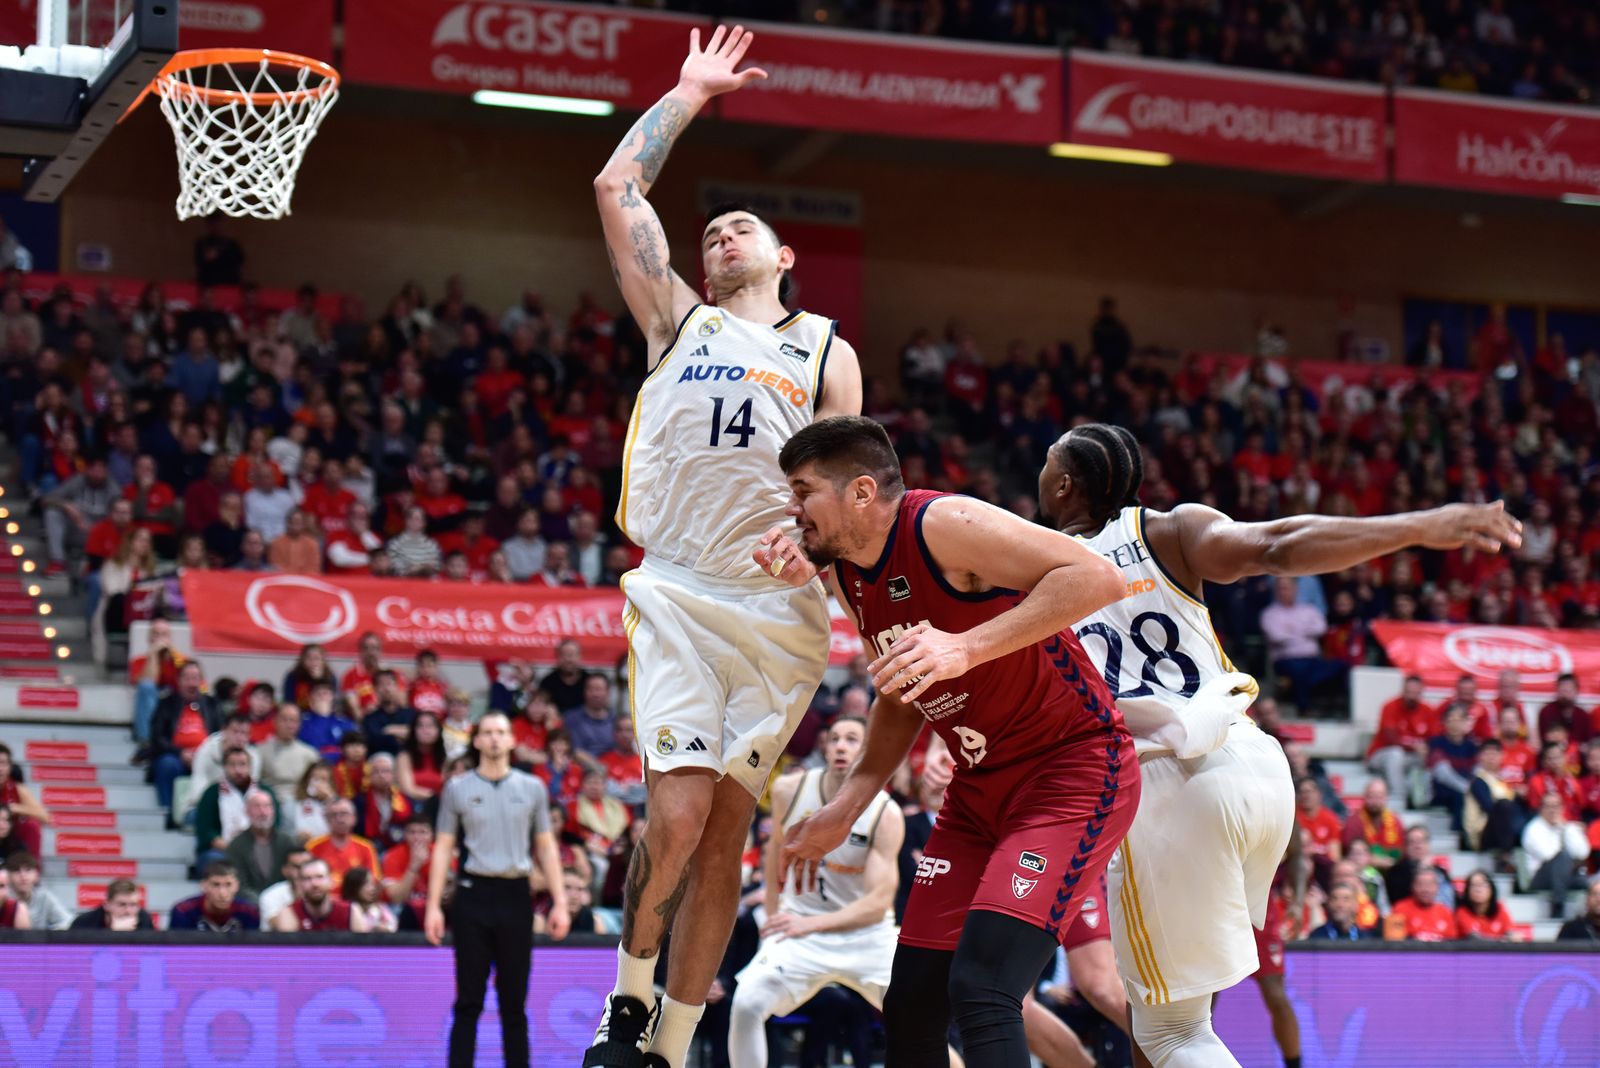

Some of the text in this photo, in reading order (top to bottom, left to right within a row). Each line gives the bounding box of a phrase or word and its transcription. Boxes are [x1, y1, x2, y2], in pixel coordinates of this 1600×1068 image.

[474, 6, 632, 60] caser
[431, 54, 518, 86] Grupo
[1129, 94, 1376, 156] GRUPOSURESTE
[677, 365, 808, 408] AUTOHERO
[709, 397, 756, 448] 14
[375, 596, 498, 632] Costa
[1077, 611, 1201, 700] 28
[921, 692, 953, 709] CARAVACA
[1022, 857, 1039, 871] acb
